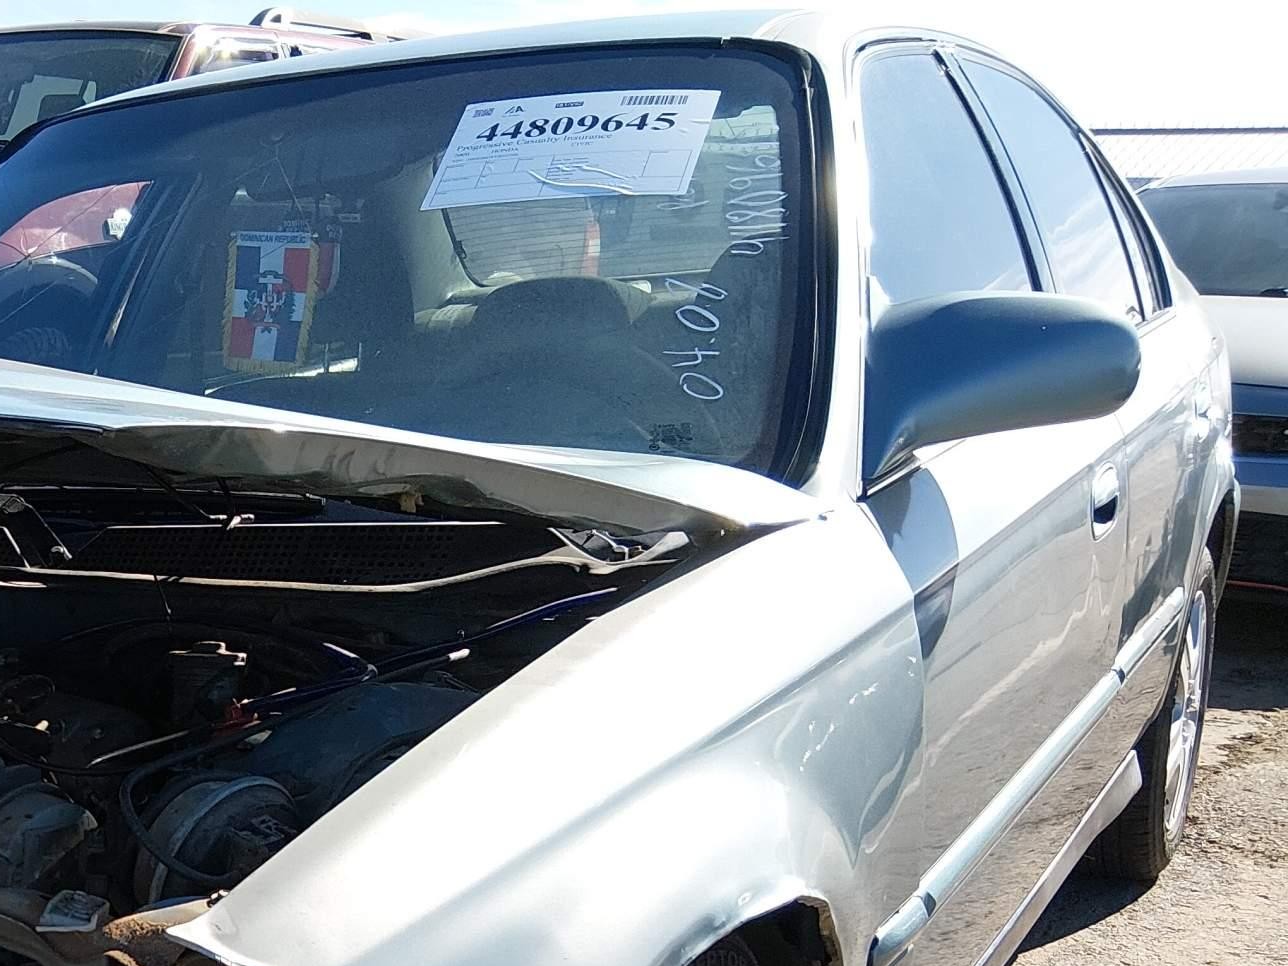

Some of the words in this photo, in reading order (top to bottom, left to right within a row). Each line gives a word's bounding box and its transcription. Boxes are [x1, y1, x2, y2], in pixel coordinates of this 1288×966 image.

[475, 112, 679, 141] 44809645
[456, 141, 513, 152] Progressive
[517, 137, 561, 146] Casualty
[563, 133, 614, 142] Insurance
[239, 232, 274, 243] DOMINICAN
[274, 233, 307, 244] REPUBLIC
